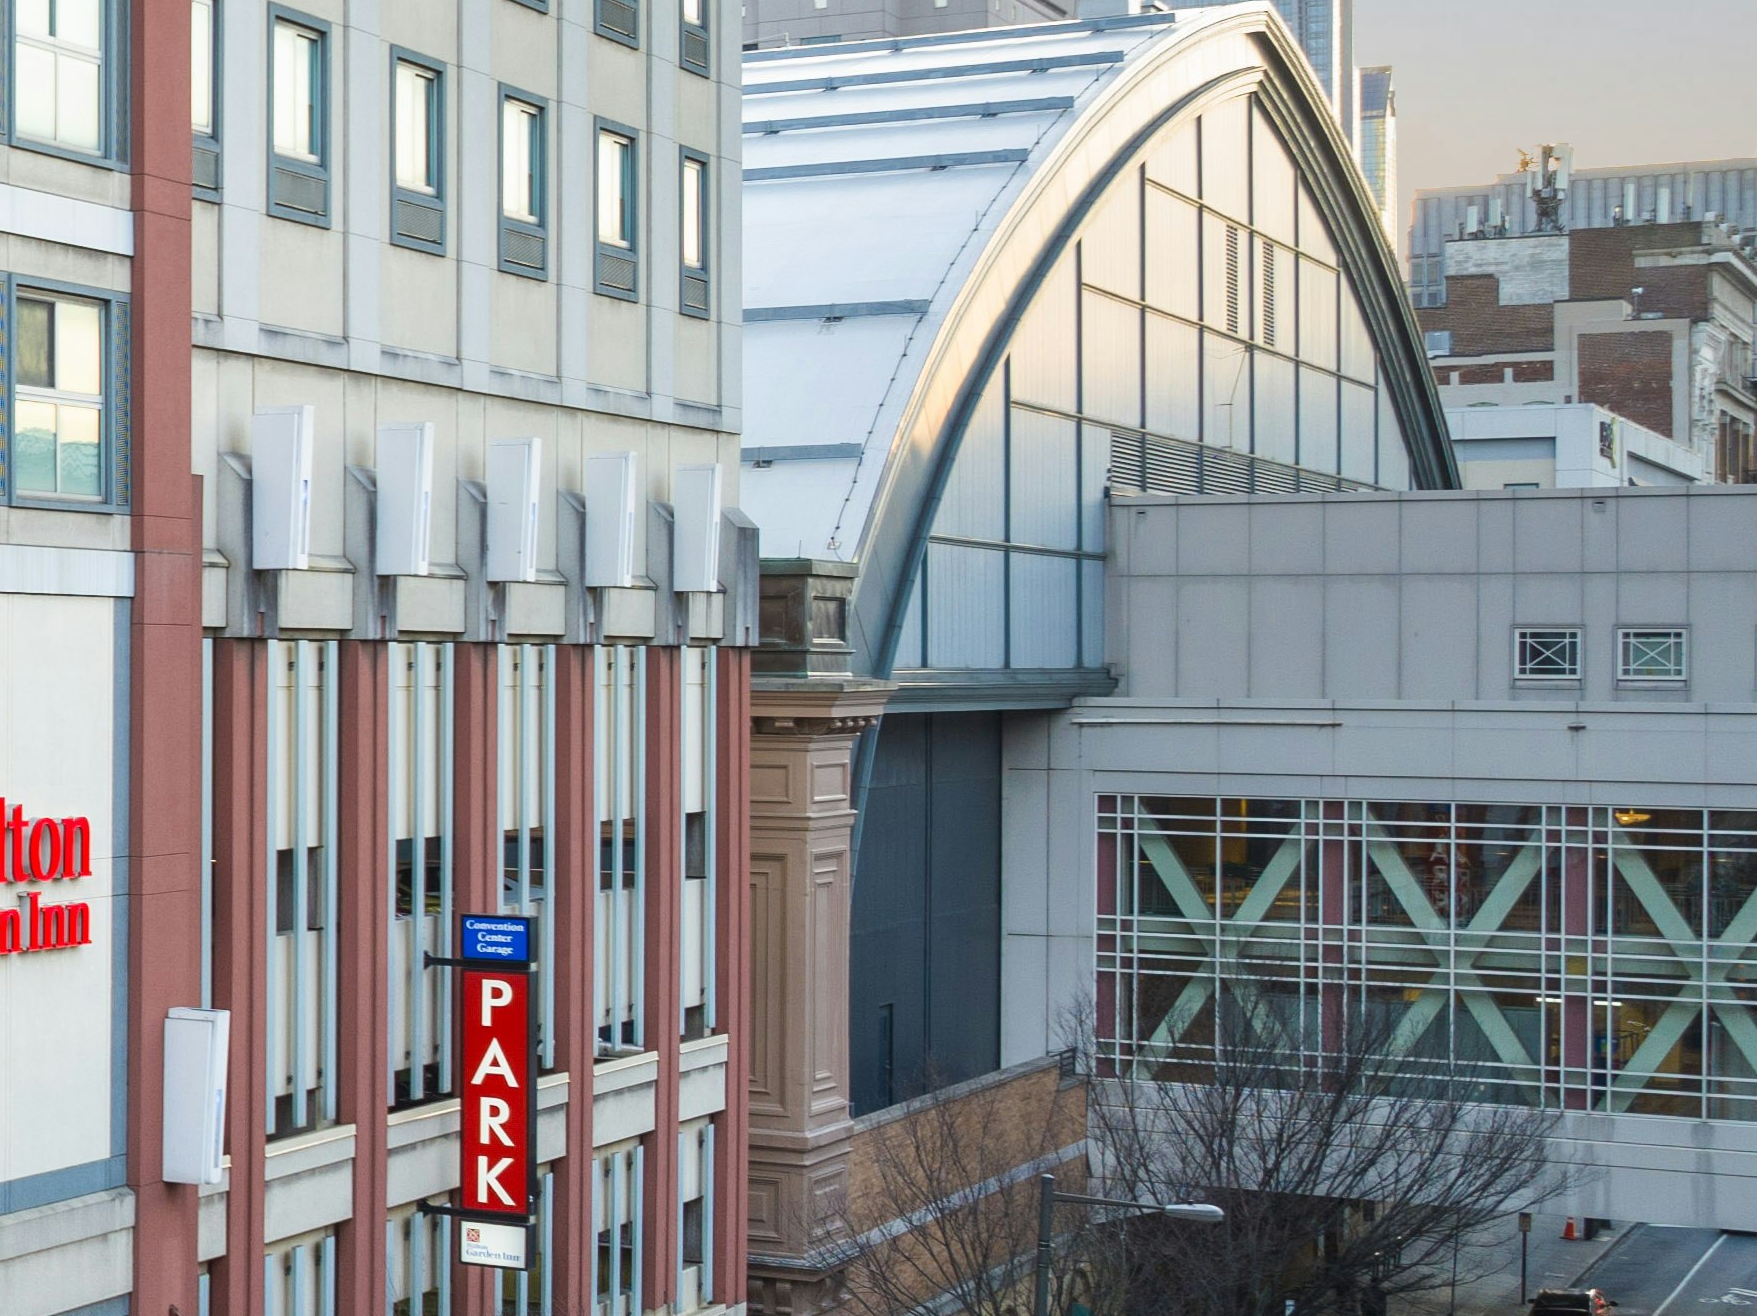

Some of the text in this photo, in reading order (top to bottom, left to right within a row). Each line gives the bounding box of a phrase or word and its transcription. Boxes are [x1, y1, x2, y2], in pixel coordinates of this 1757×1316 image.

[25, 891, 92, 951] Inn
[466, 919, 525, 932] Convention
[477, 931, 513, 942] Center
[476, 943, 514, 956] Garage
[471, 978, 519, 1207] PARK
